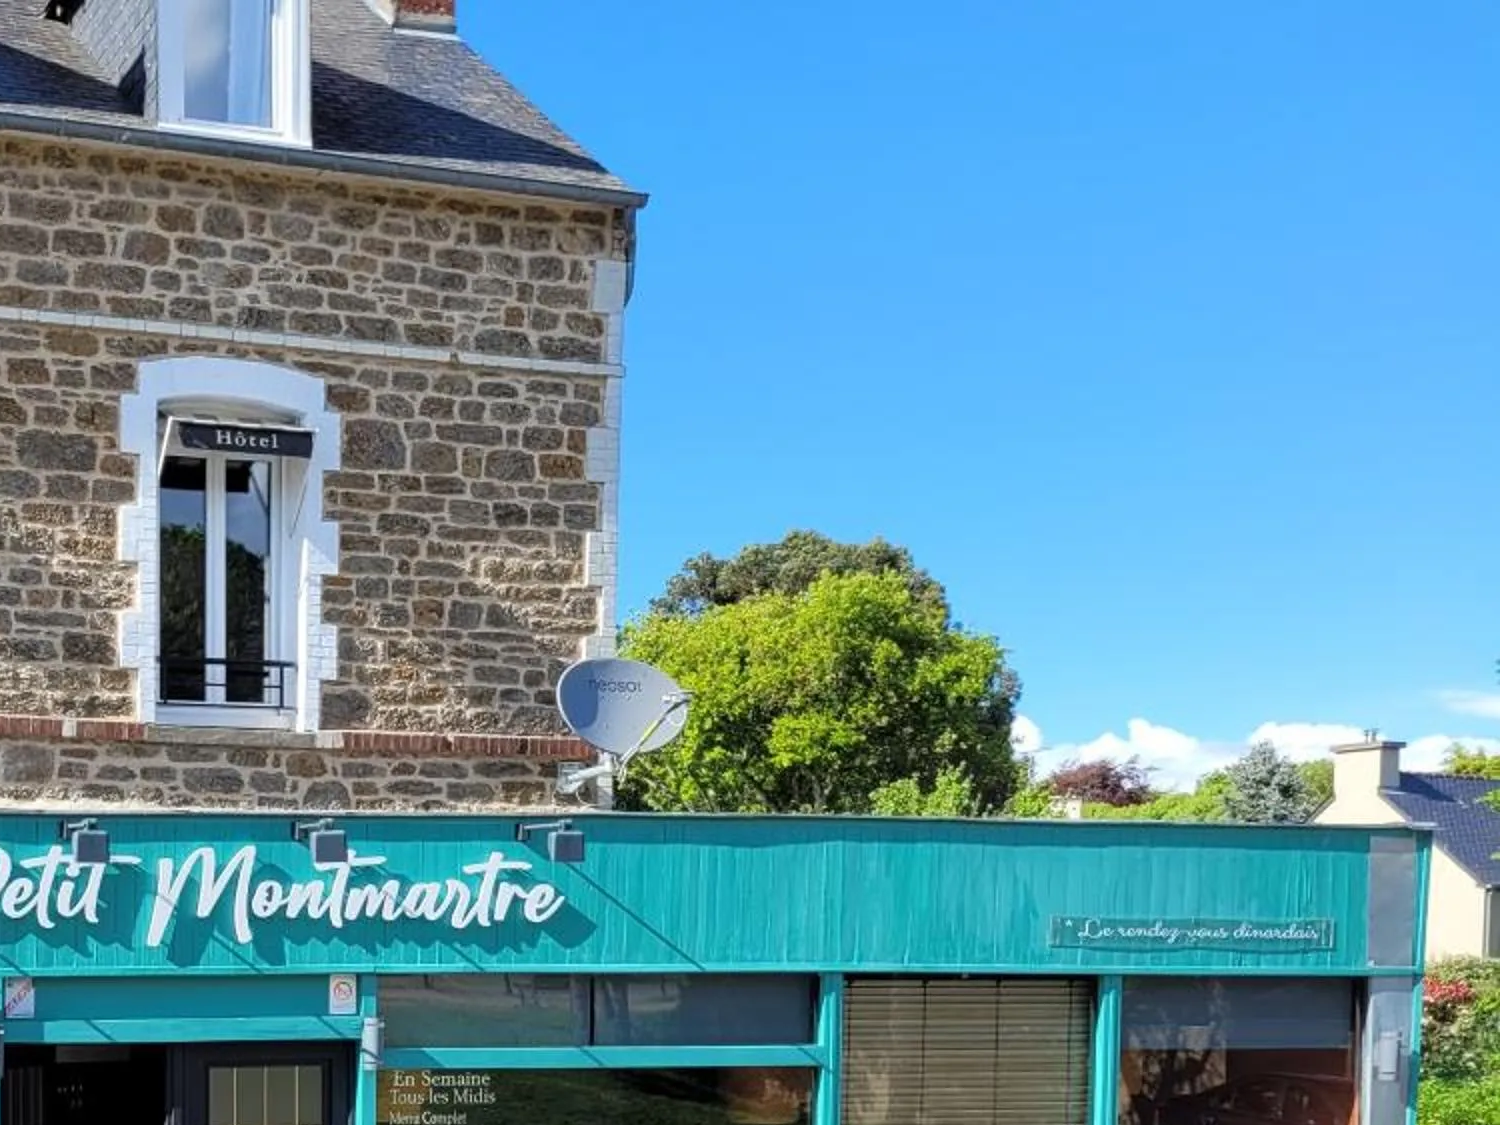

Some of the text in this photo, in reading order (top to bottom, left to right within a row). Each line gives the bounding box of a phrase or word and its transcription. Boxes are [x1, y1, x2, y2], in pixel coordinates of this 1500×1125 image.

[216, 429, 280, 449] Hôtel
[145, 845, 565, 947] Montmartre
[1077, 919, 1115, 938] Le
[393, 1070, 492, 1087] En Semaine
[389, 1088, 497, 1105] Tous les Midis
